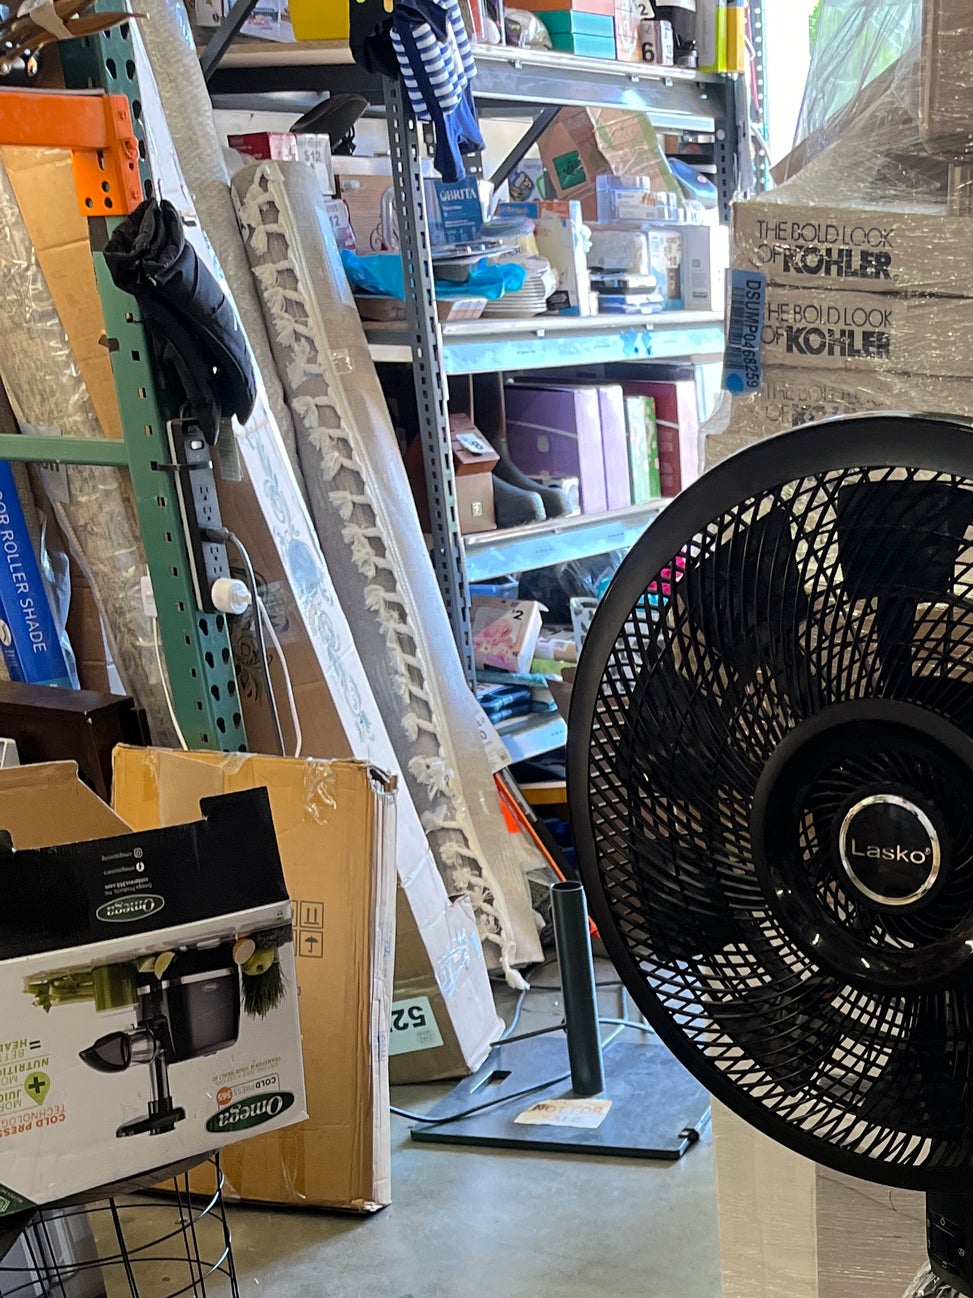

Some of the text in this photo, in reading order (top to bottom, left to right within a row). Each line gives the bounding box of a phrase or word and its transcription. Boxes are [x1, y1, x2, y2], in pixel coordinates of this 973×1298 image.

[641, 42, 655, 62] 6
[446, 188, 477, 200] BRITA
[757, 220, 896, 248] THE BOLD LOOK
[757, 244, 892, 281] OF KOHLER
[766, 302, 893, 328] HE BOLD LOOK
[760, 325, 891, 359] OF KOHLER
[1, 530, 29, 594] ROLLER
[20, 597, 47, 654] SHADE
[851, 838, 926, 865] Lasko
[106, 898, 155, 917] Omega
[36, 1113, 66, 1128] COLD
[218, 1095, 284, 1127] Omega
[533, 1103, 565, 1113] NOT
